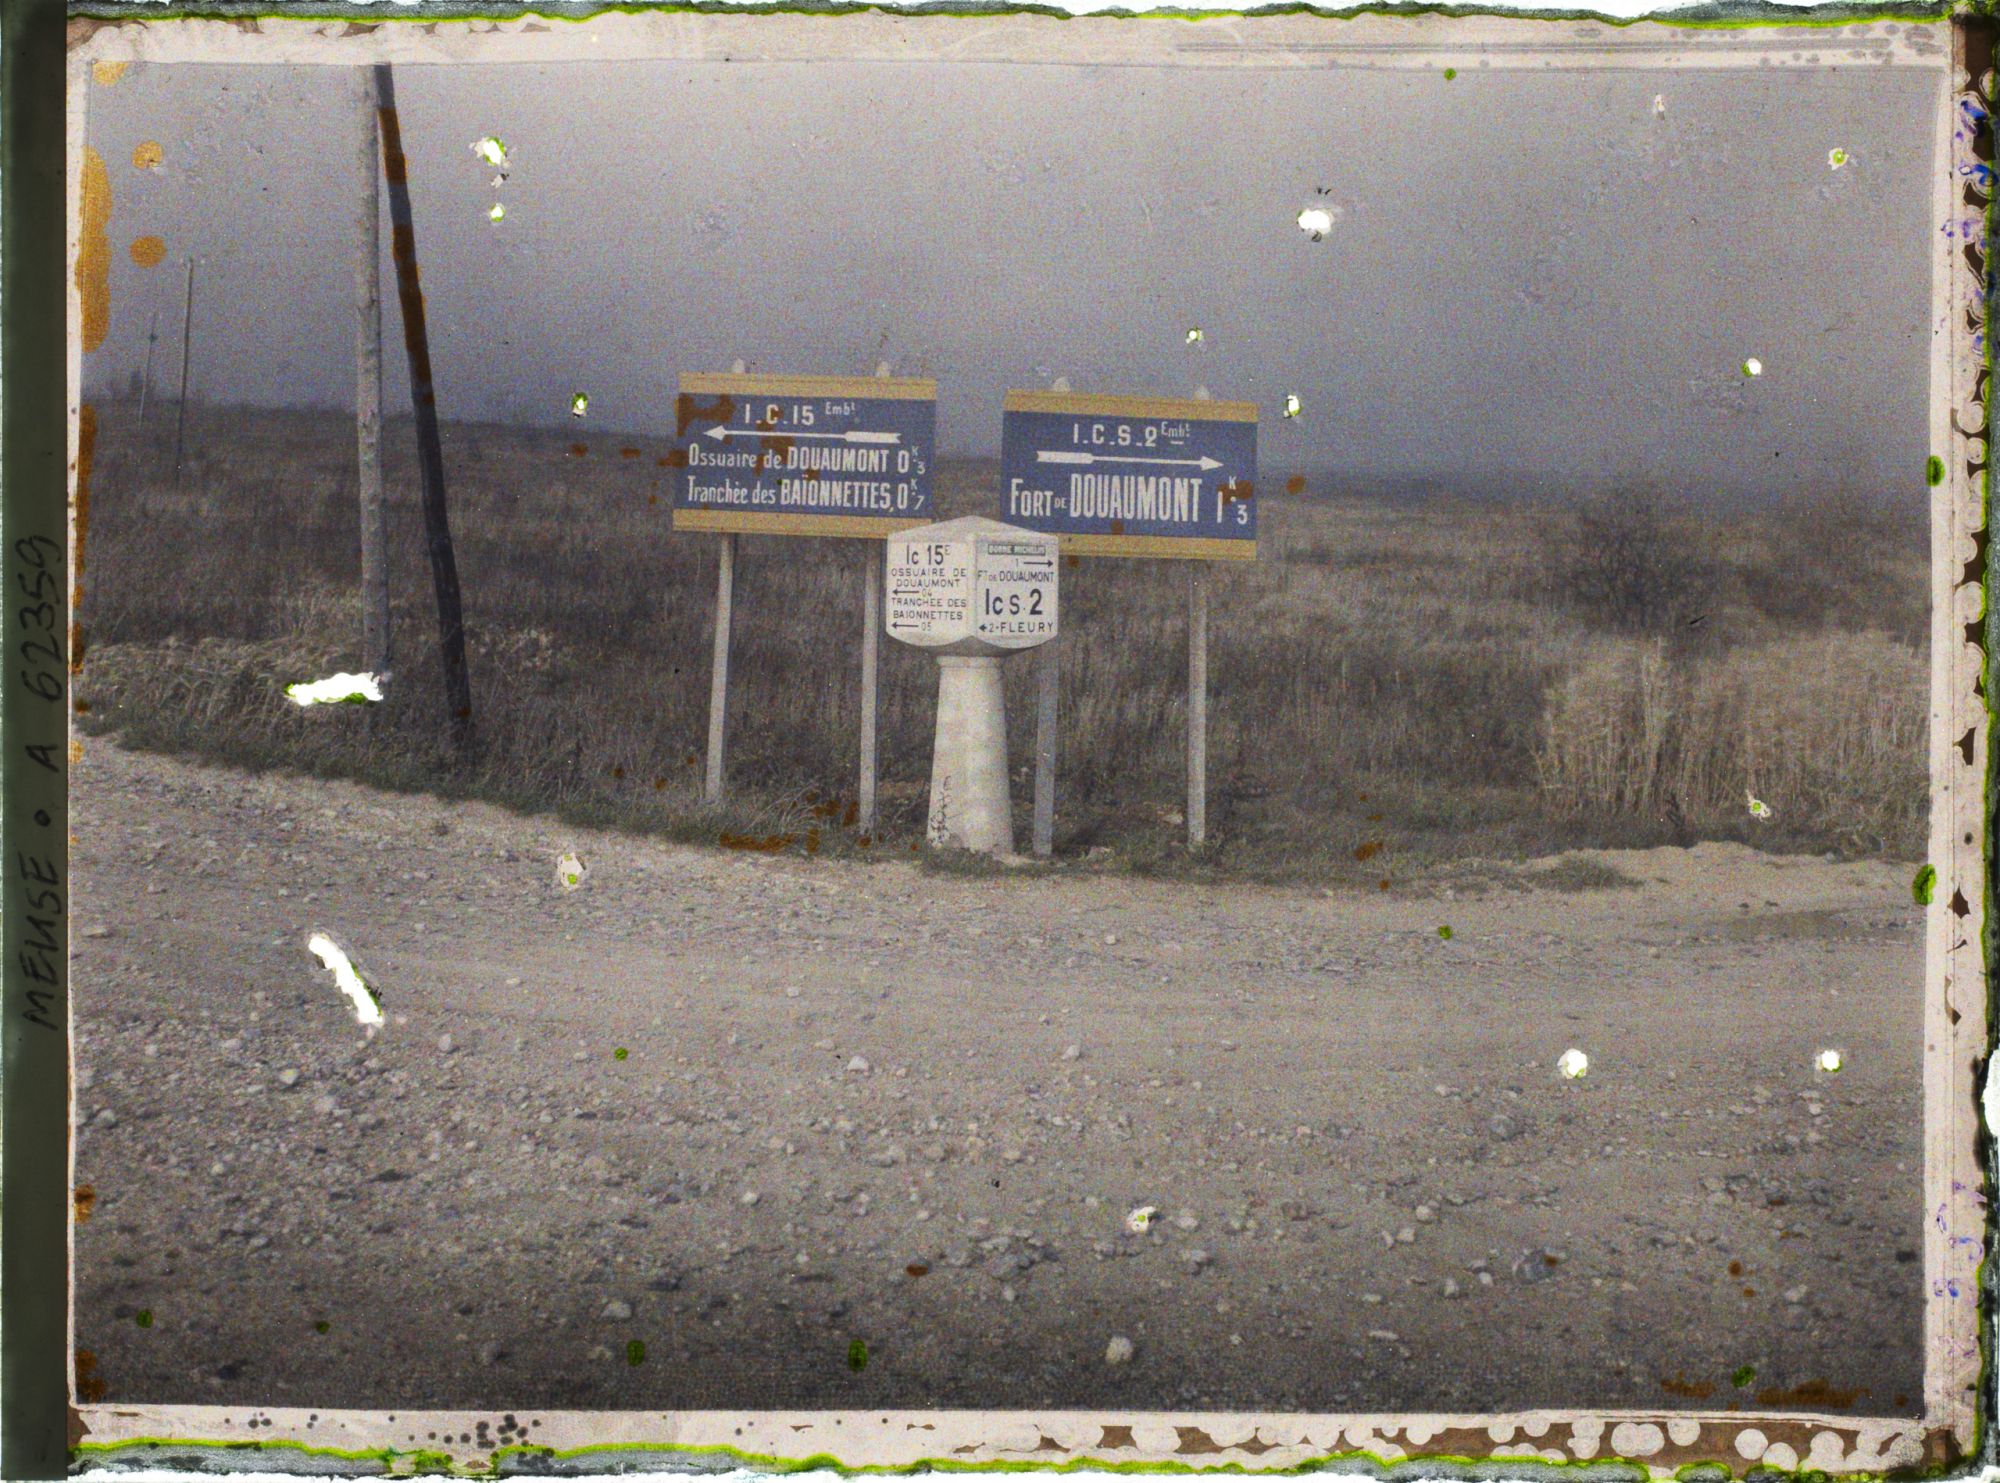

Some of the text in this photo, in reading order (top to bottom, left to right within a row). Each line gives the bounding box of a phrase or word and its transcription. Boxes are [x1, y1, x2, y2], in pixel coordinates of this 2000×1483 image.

[688, 442, 757, 468] Ossuaire
[763, 449, 782, 469] de
[787, 446, 889, 473] DOUAUMONT
[687, 475, 748, 504] Tranchée
[751, 480, 776, 505] des
[1054, 497, 1067, 509] DE
[1070, 473, 1202, 523] DOUAUMONT
[891, 568, 967, 577] OSSUAIRE DE
[999, 570, 1054, 582] DOUAUMONT
[896, 579, 960, 588] DOUAUMONT
[947, 598, 967, 608] DES
[14, 535, 62, 1031] MEUSE A 62359
